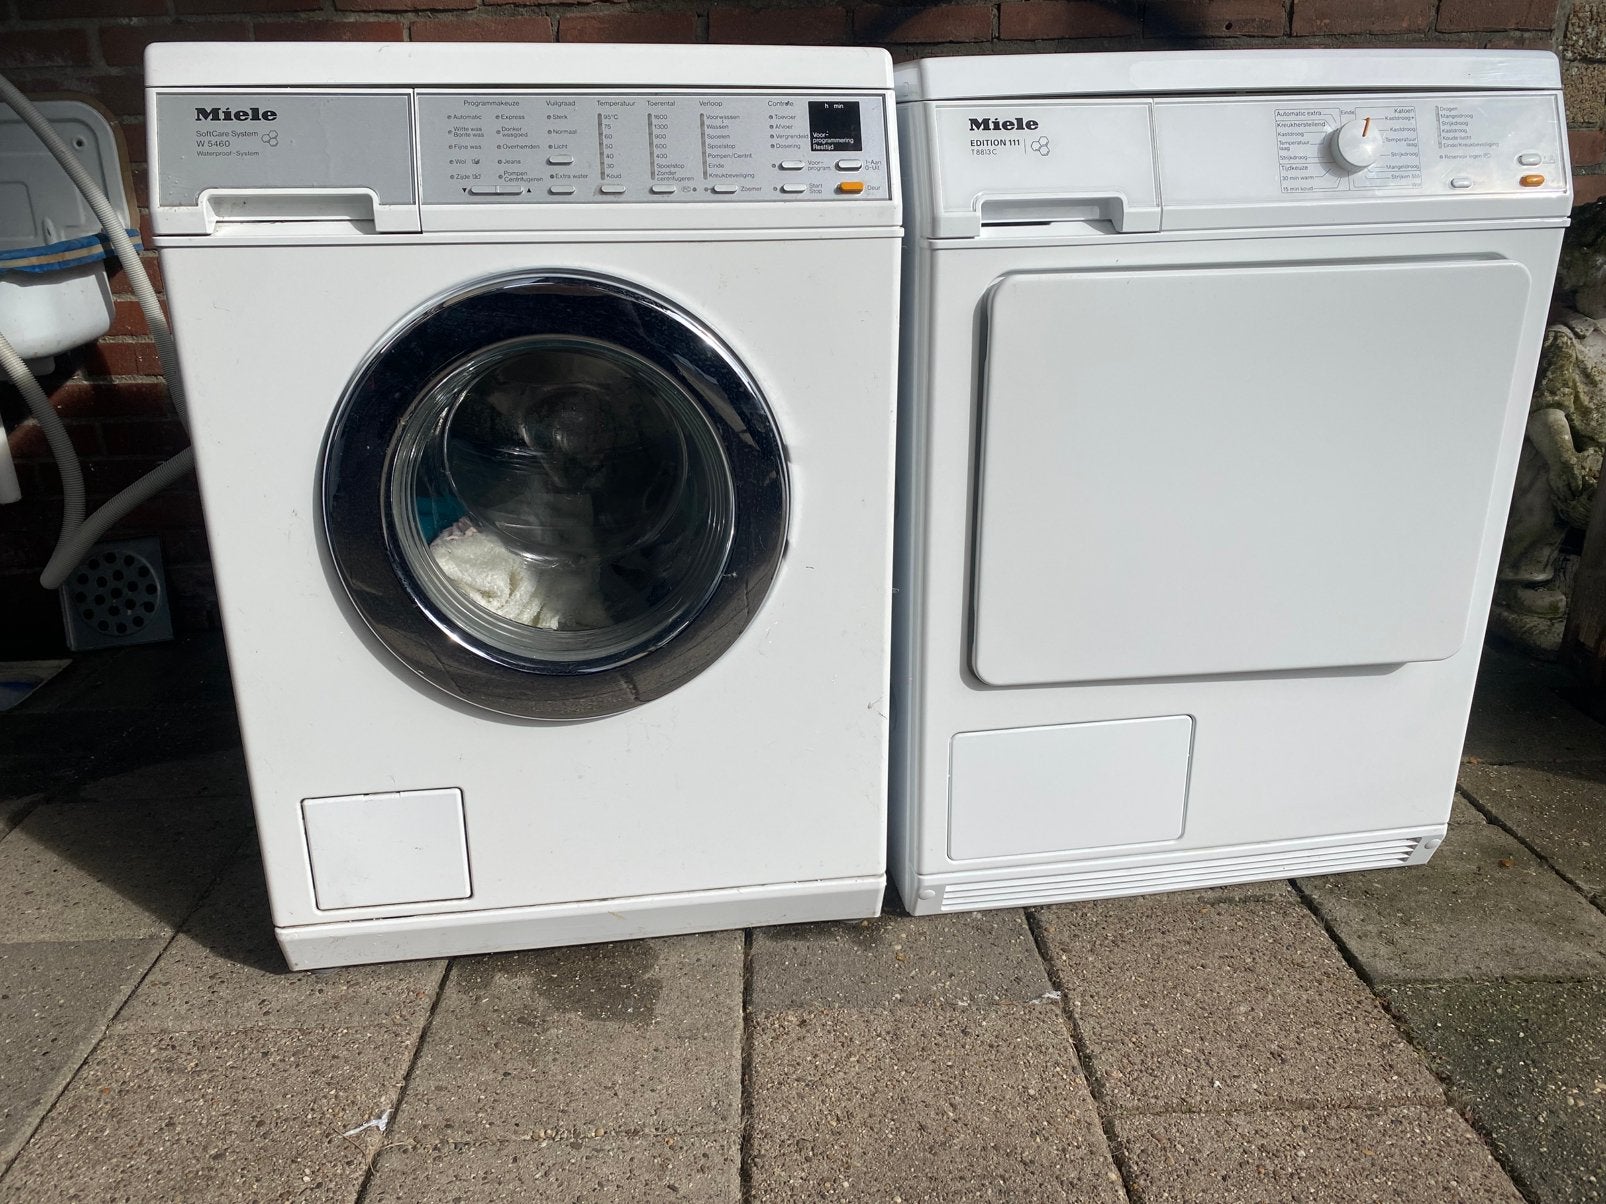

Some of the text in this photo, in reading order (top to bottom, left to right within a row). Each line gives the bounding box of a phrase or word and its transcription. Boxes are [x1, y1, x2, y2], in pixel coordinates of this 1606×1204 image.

[463, 99, 520, 107] Programmakeuze
[195, 107, 278, 121] Miele
[968, 117, 1039, 131] Miele
[196, 130, 259, 139] SoftCare System
[207, 140, 231, 148] 5460
[970, 139, 1006, 147] EDITION
